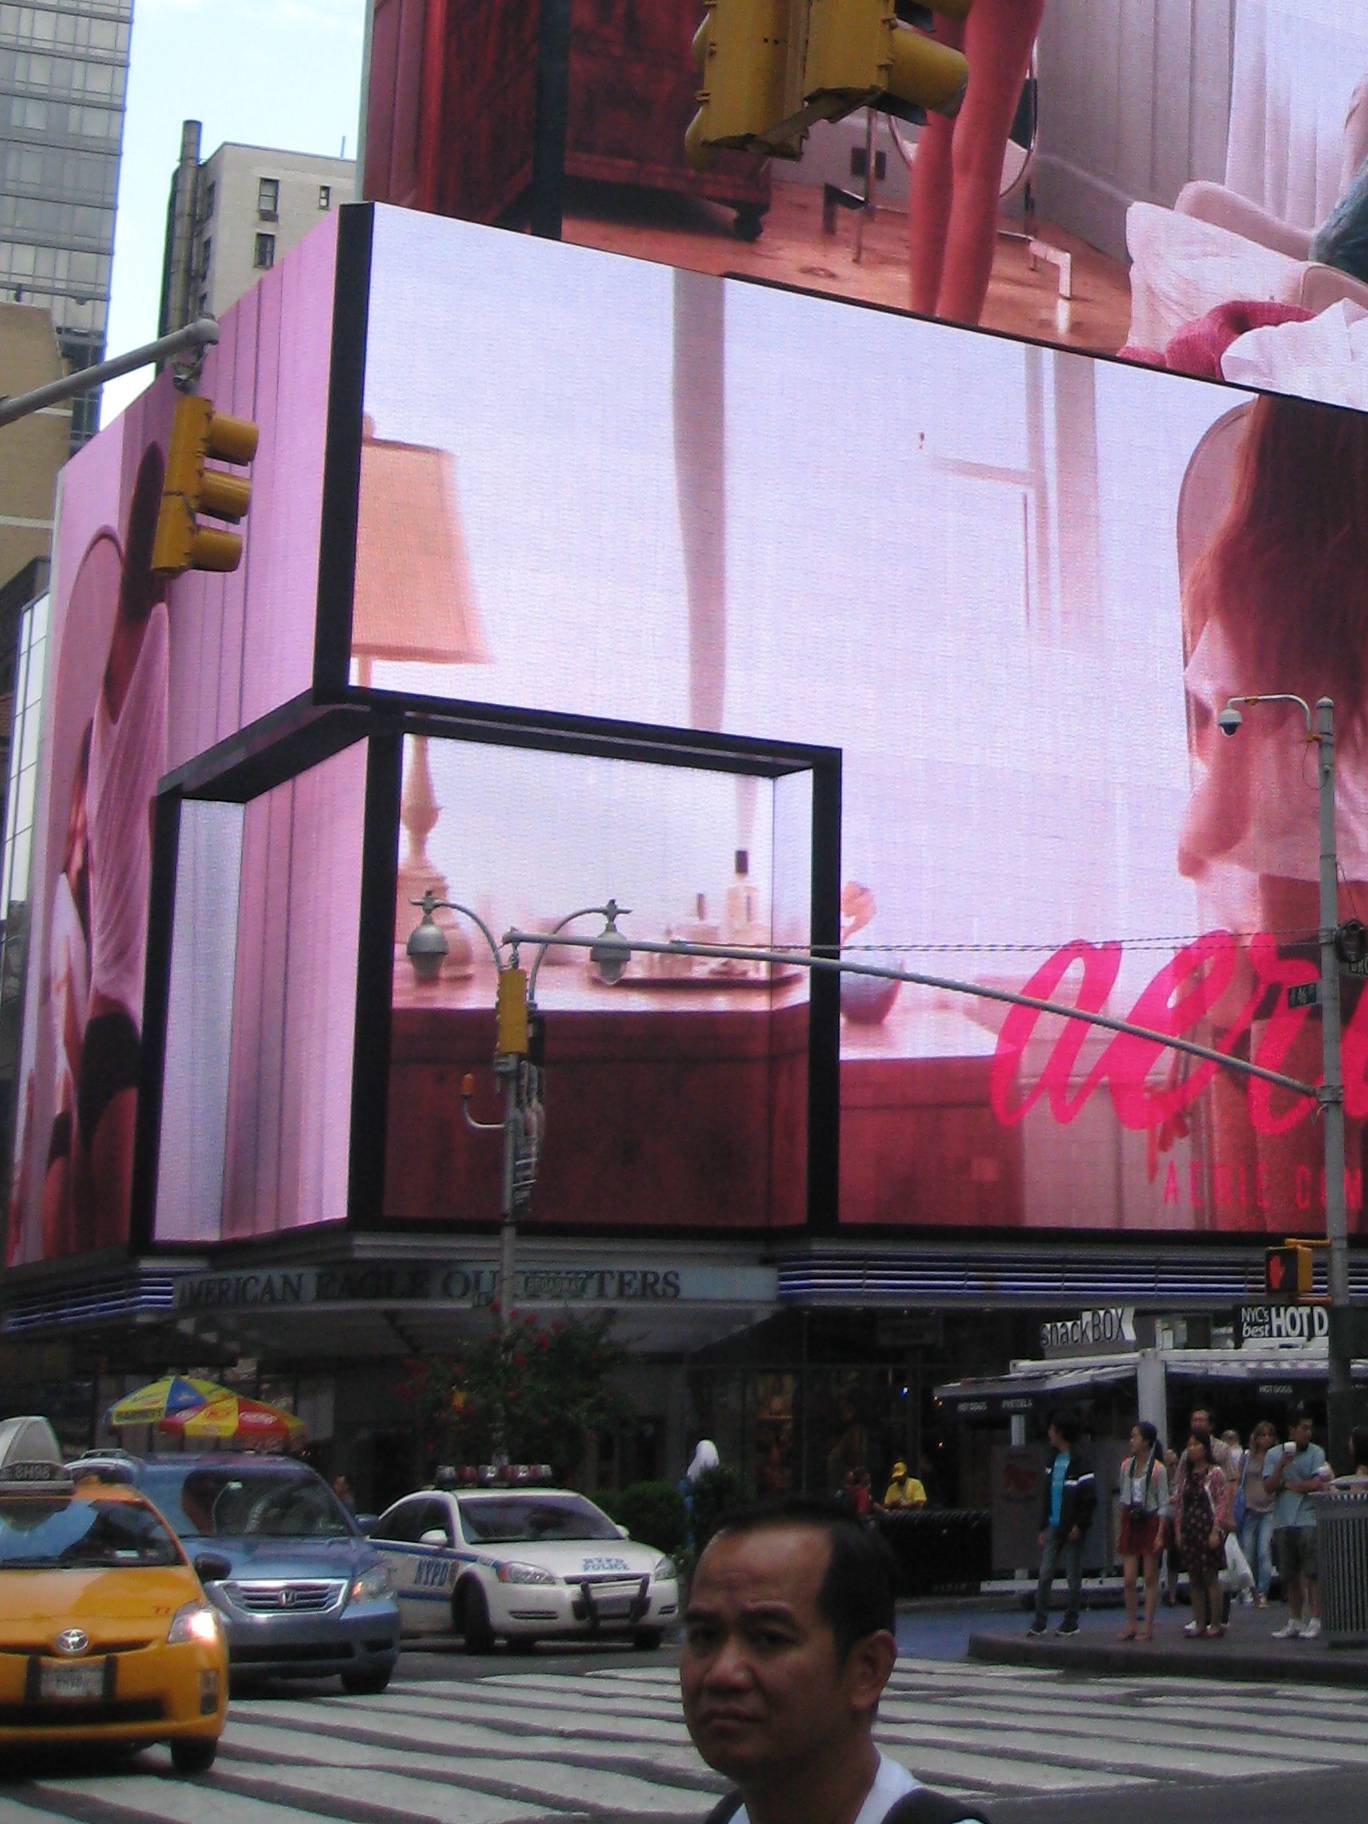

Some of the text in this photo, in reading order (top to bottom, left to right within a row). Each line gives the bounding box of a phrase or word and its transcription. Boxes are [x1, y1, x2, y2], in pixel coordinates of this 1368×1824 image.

[1164, 1162, 1363, 1210] AERIE.CM
[178, 1272, 304, 1307] AMERICAN
[1039, 1308, 1125, 1347] snackBOX
[1241, 1323, 1270, 1338] best
[1271, 1307, 1310, 1337] HOT
[413, 1559, 449, 1587] NYPD
